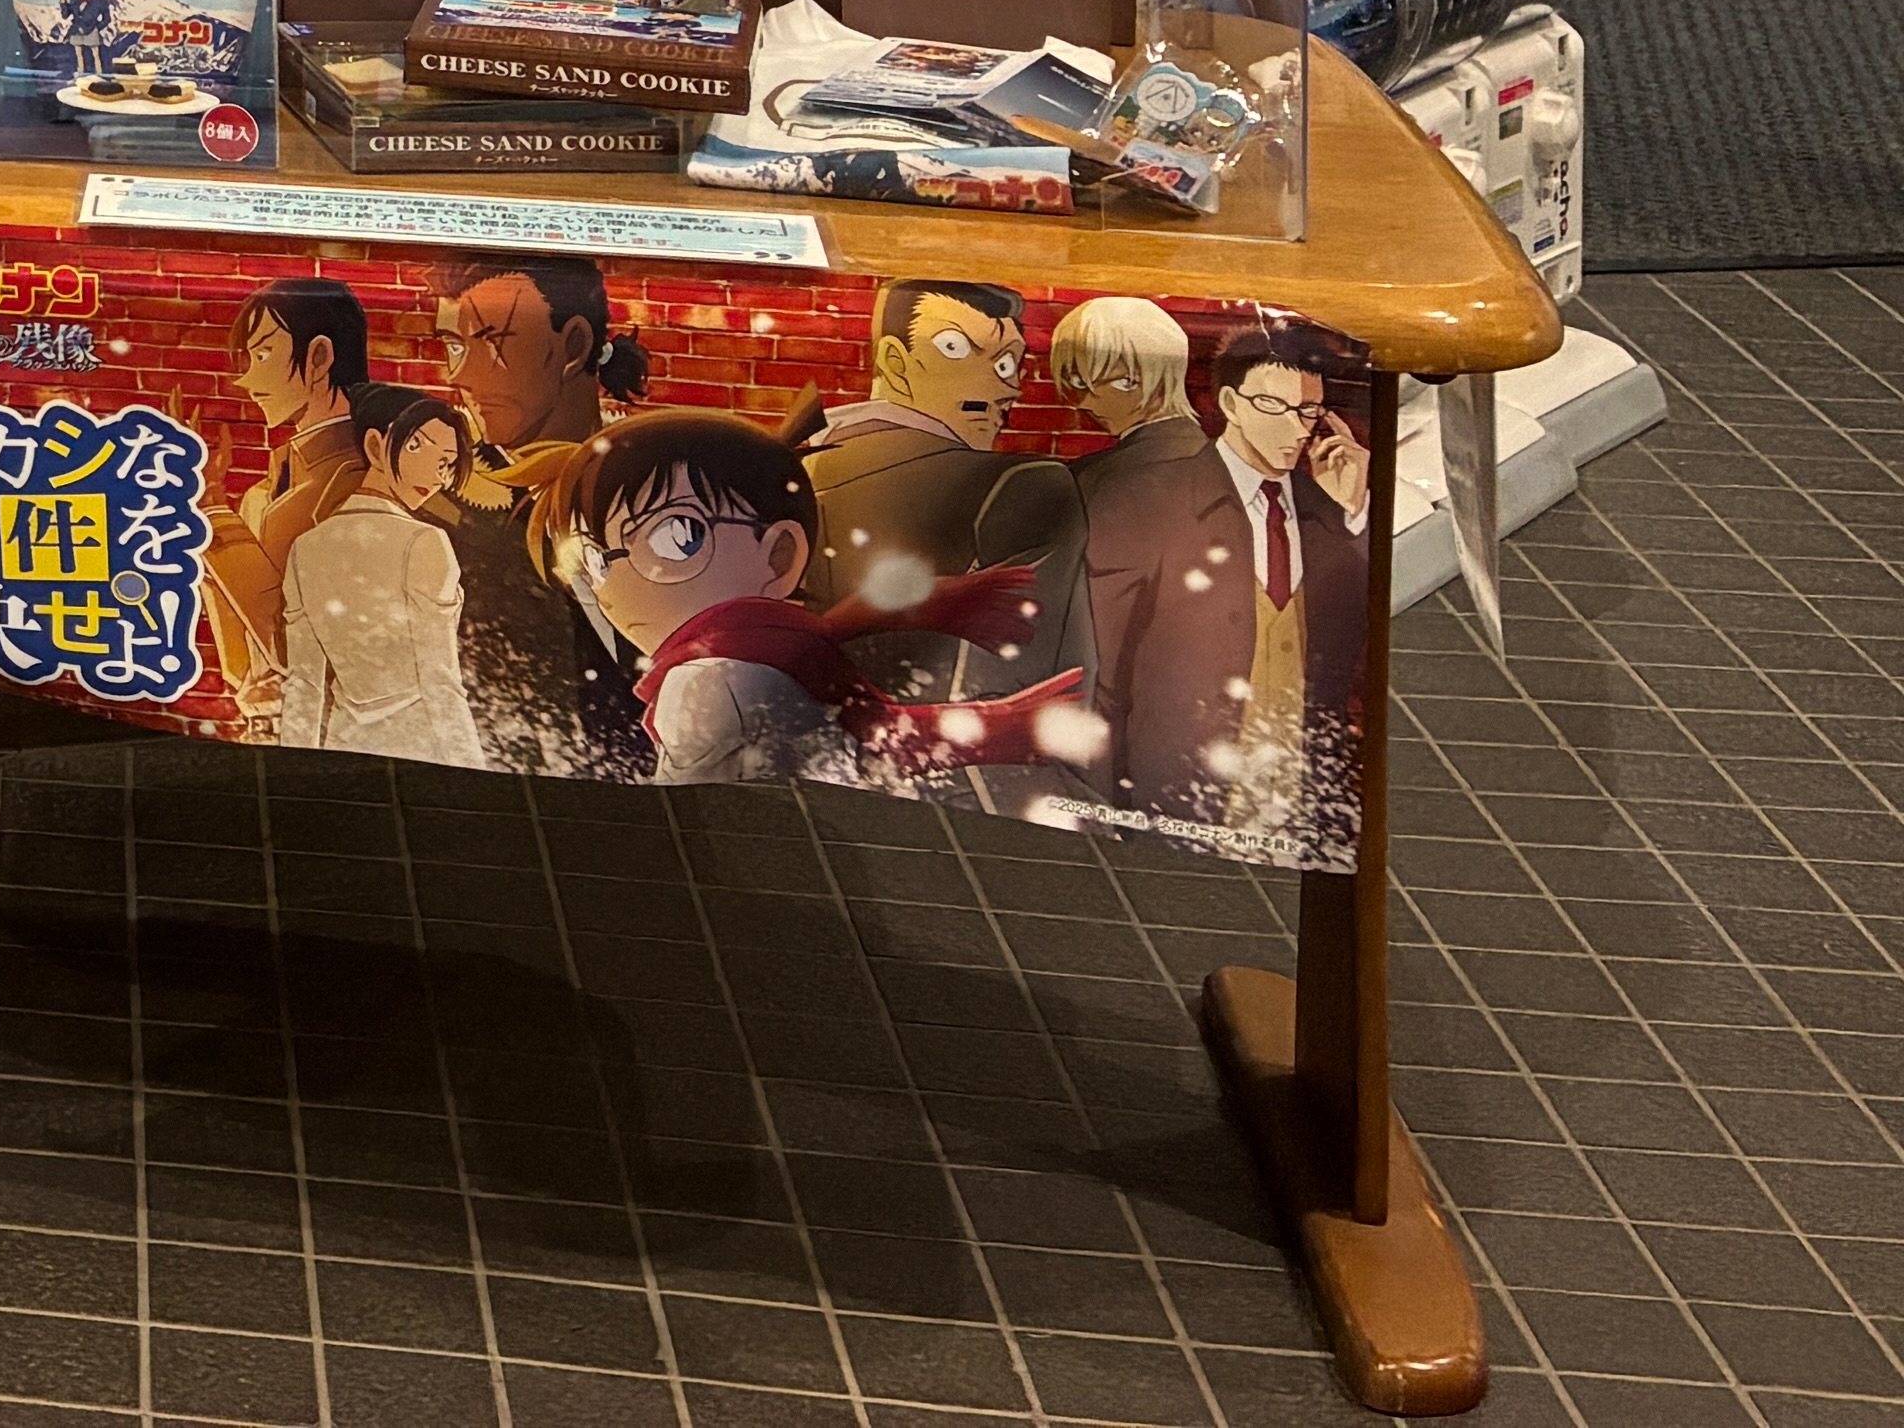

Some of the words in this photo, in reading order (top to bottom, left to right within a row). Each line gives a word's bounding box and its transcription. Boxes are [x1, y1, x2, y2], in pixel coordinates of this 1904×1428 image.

[141, 21, 211, 45] コナン
[421, 53, 527, 81] CHEESE
[535, 63, 612, 88] SAND
[626, 69, 732, 97] COOKIE
[204, 120, 251, 144] 8個入
[368, 135, 472, 153] CHEESE
[479, 134, 553, 152] SAND
[564, 134, 664, 152] COOKIE
